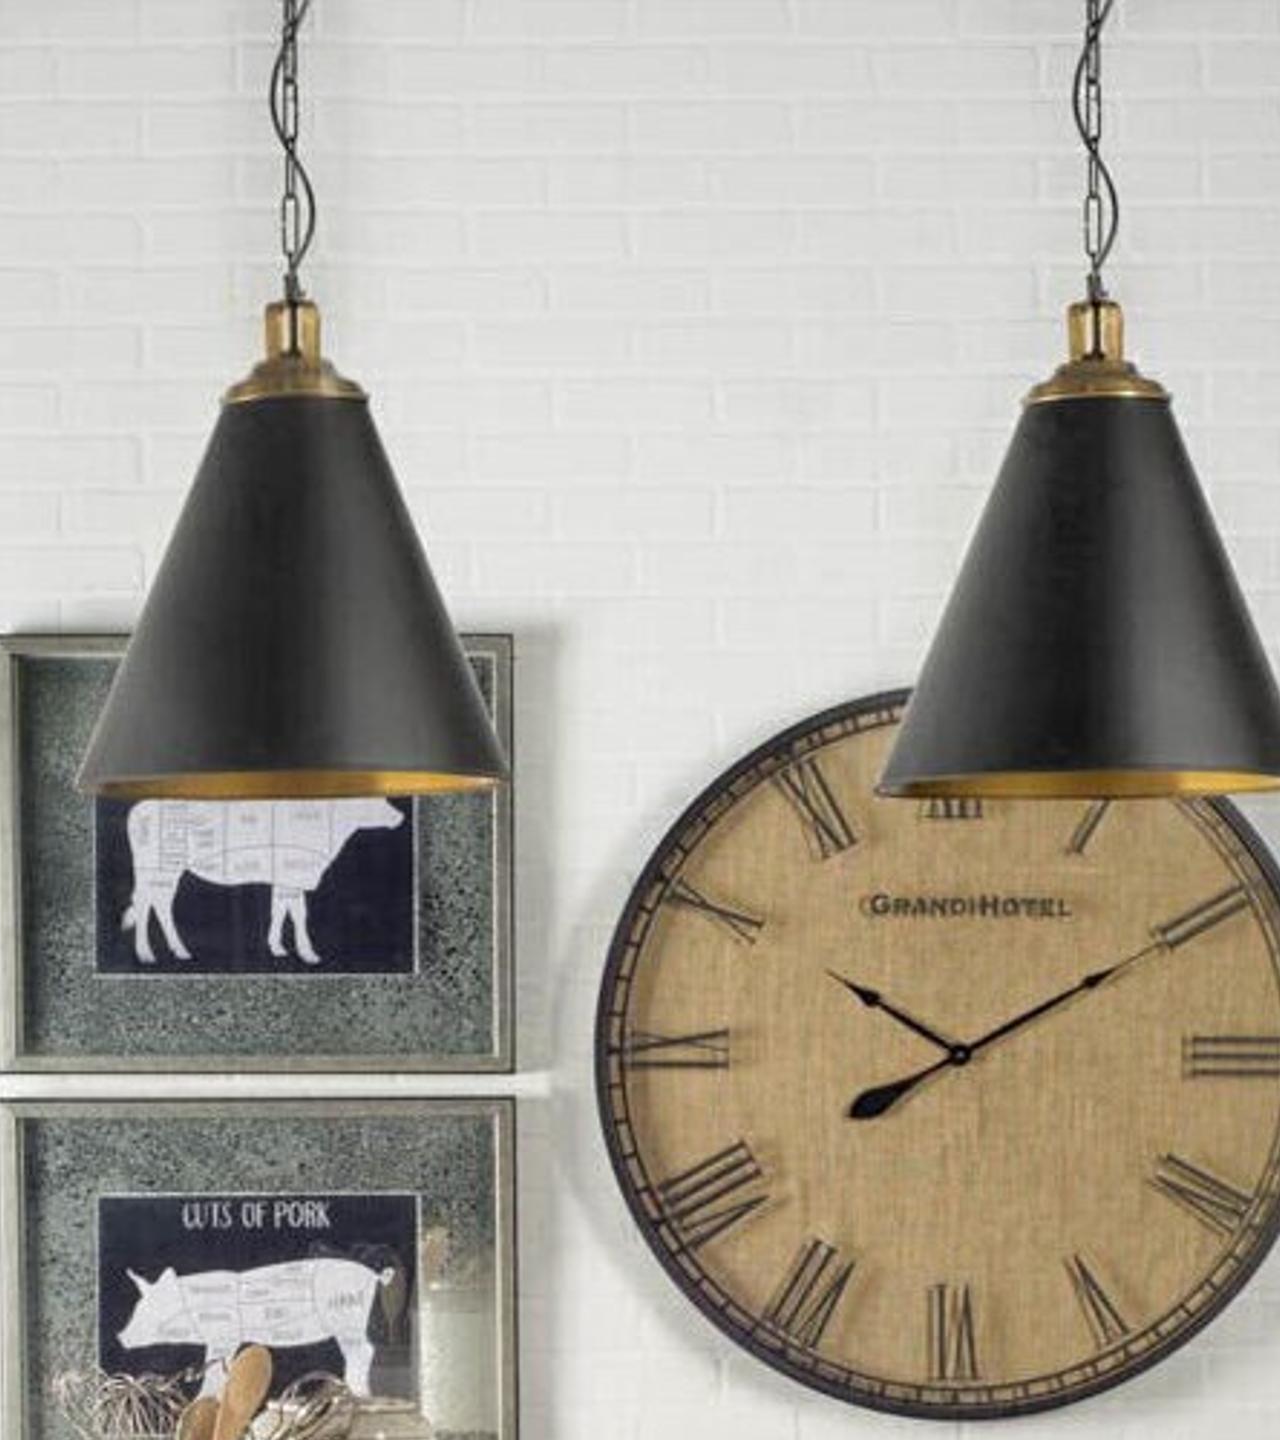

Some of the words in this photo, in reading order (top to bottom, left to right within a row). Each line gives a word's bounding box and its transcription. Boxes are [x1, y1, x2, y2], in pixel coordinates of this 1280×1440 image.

[182, 1200, 233, 1229] CUTS
[241, 1200, 269, 1229] OF
[273, 1200, 331, 1229] PORK
